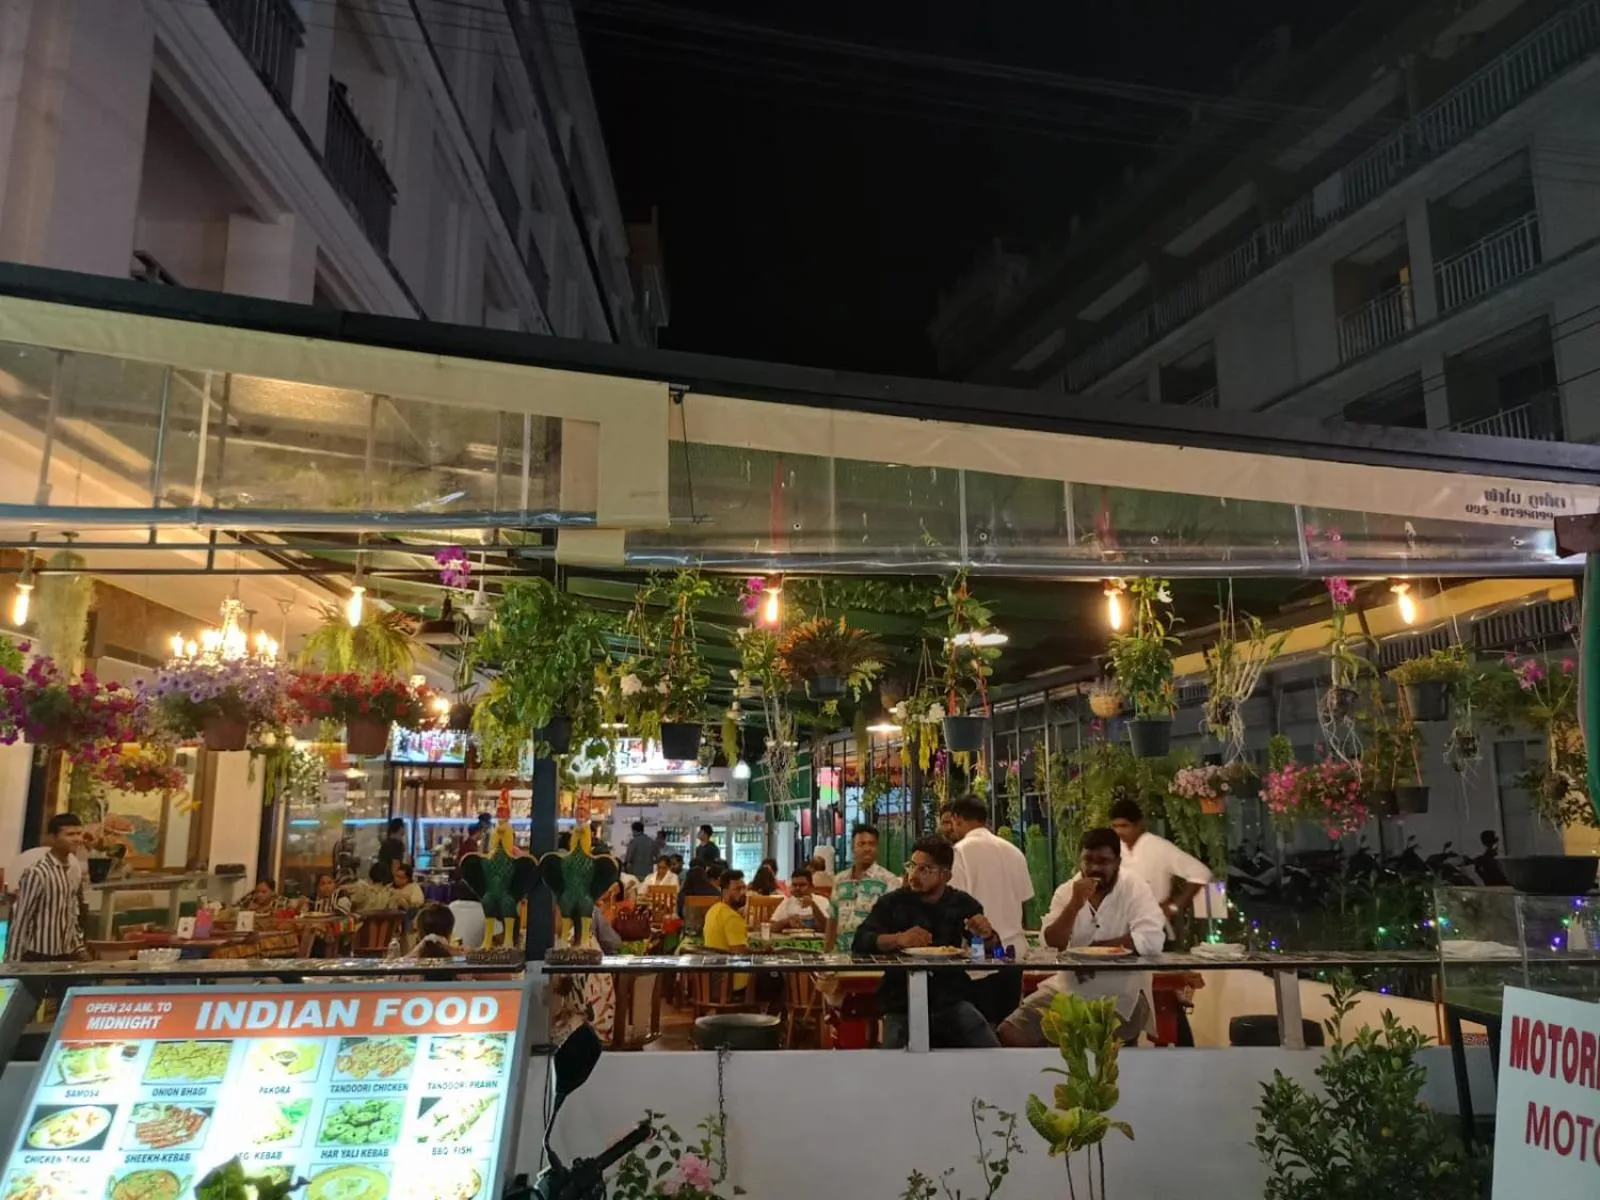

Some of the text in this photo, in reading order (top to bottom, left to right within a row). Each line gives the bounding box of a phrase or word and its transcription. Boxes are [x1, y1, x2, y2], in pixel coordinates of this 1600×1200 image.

[86, 1002, 117, 1013] OPEN
[119, 1003, 132, 1013] 24
[157, 1001, 173, 1012] TO
[196, 996, 498, 1030] INDIAN FOOD
[86, 1015, 163, 1030] MIDNIGHT
[330, 1083, 409, 1093] TANDOORI CHICKEN
[469, 1080, 498, 1089] PRAWN
[65, 1089, 100, 1098] SAMOSA
[152, 1088, 179, 1097] ONION
[259, 1085, 291, 1094] PAKORA
[254, 1151, 283, 1160] KEBAB
[320, 1150, 339, 1159] HAR
[360, 1148, 389, 1158] KEBAB
[24, 1155, 62, 1164] CHICKEN
